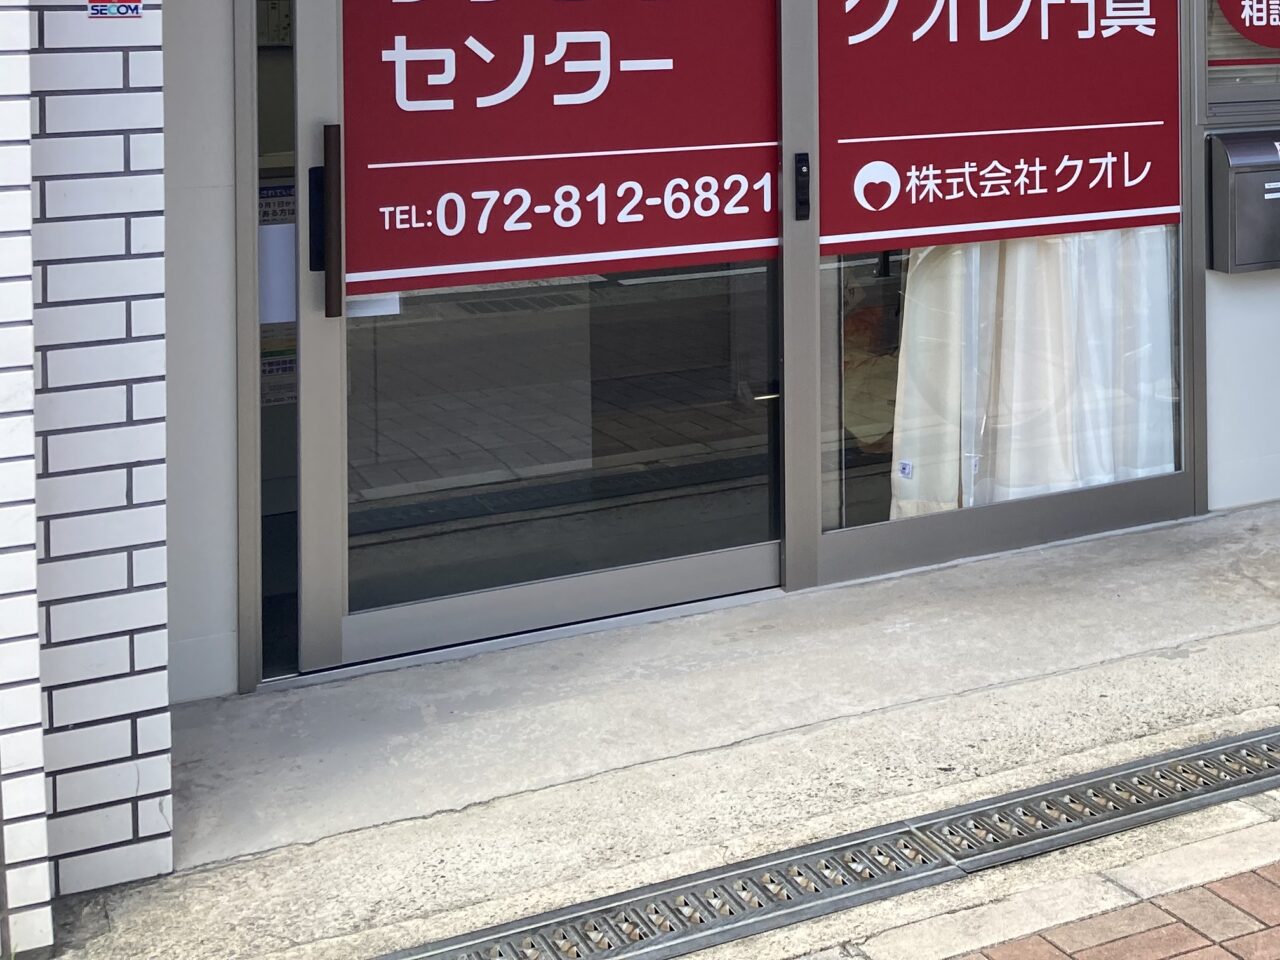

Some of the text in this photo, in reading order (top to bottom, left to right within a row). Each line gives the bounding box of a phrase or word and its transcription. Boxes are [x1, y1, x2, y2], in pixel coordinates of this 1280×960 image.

[91, 4, 139, 15] SECOM
[381, 30, 674, 112] センター
